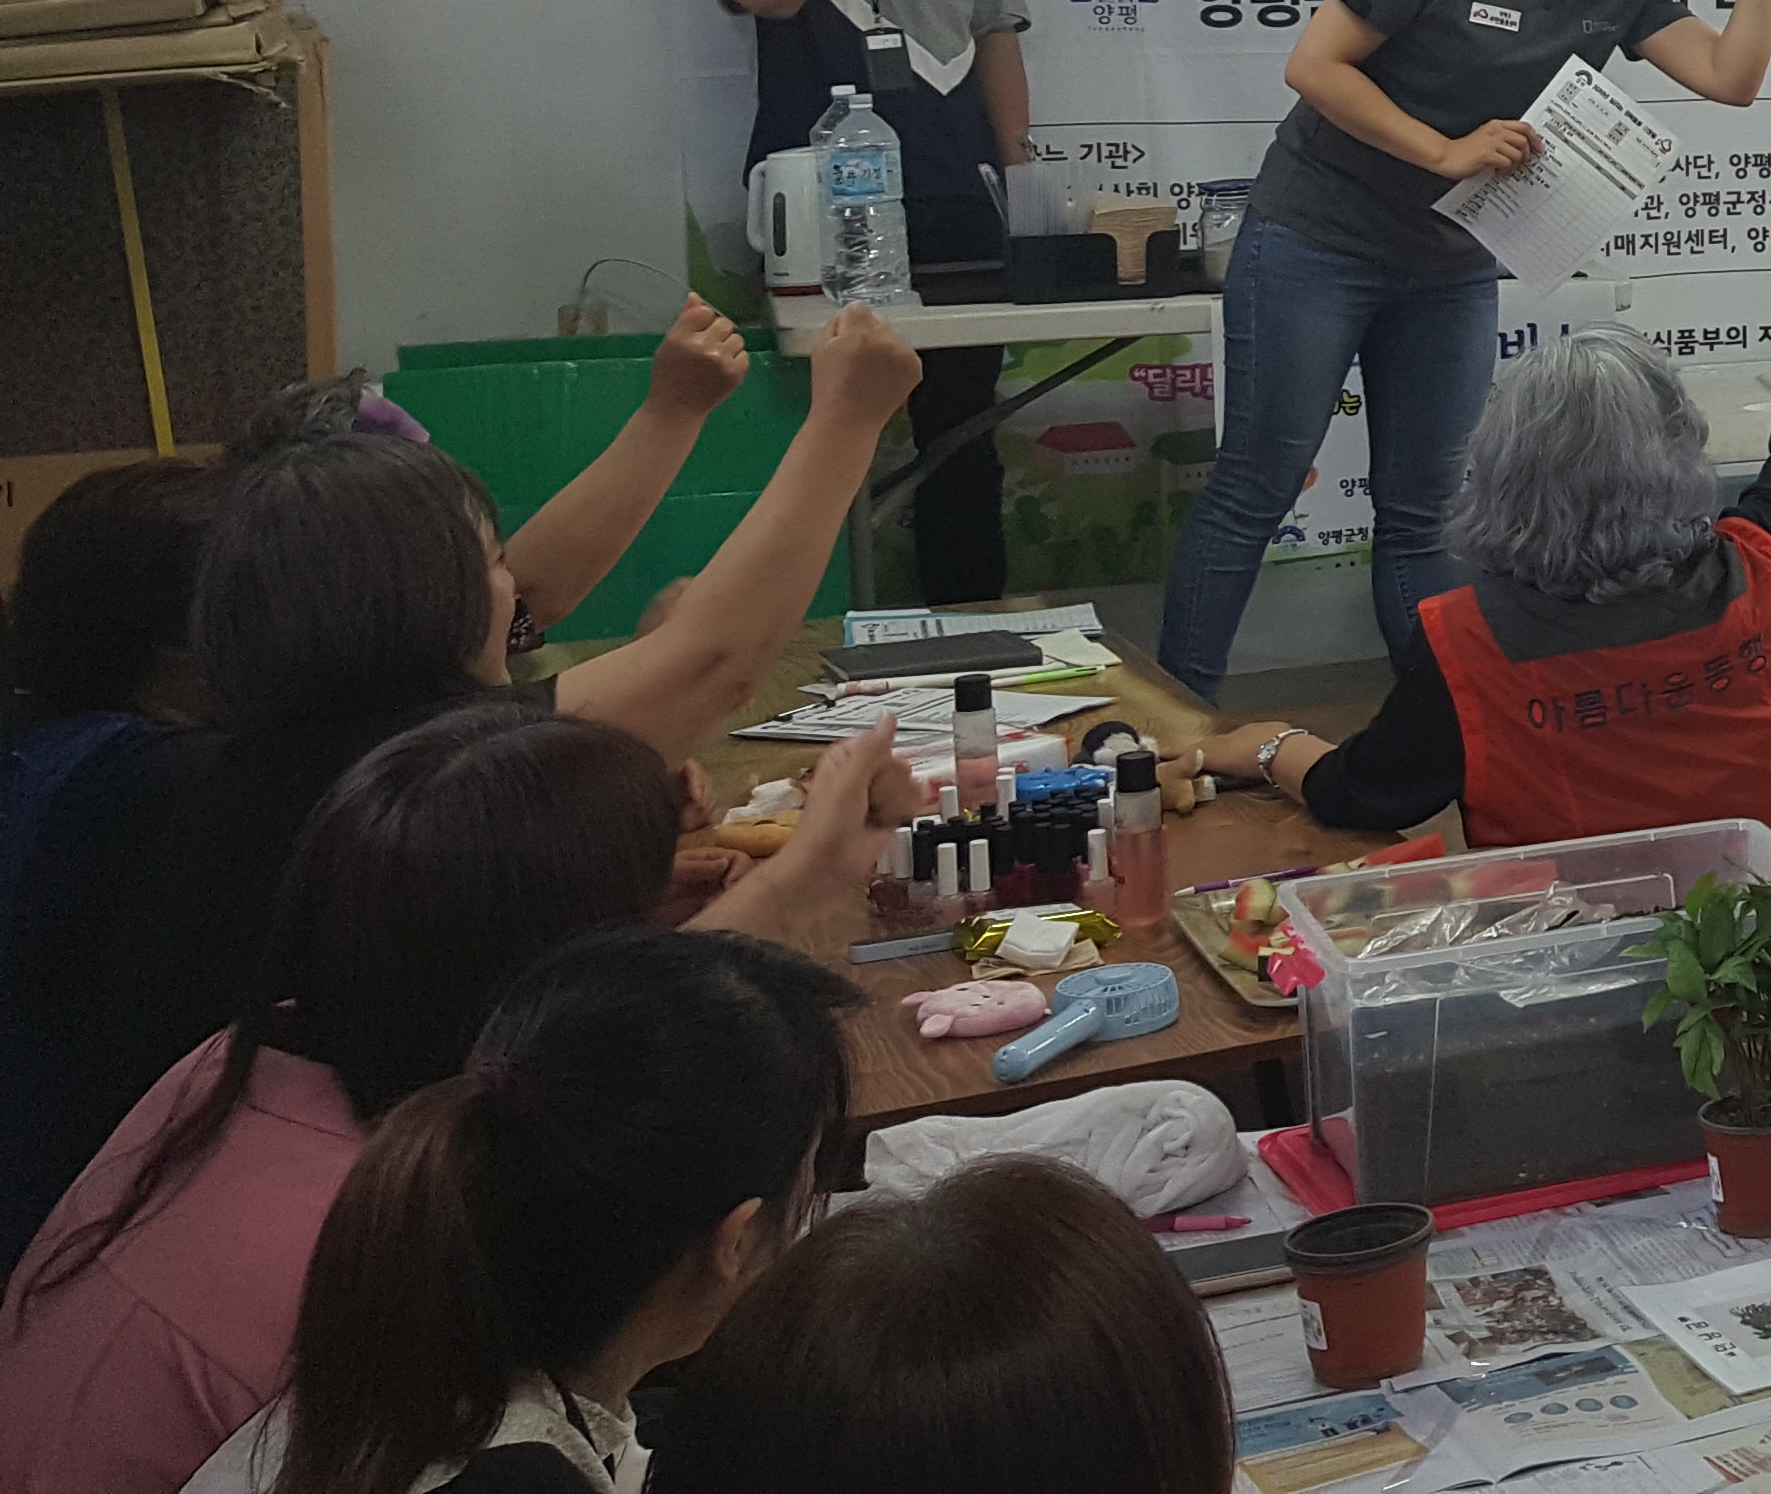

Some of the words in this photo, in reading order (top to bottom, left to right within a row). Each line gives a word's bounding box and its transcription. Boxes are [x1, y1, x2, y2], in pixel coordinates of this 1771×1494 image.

[1092, 3, 1138, 25] 양평
[1643, 323, 1748, 358] 식품부의
[1316, 526, 1370, 547] 양평군청
